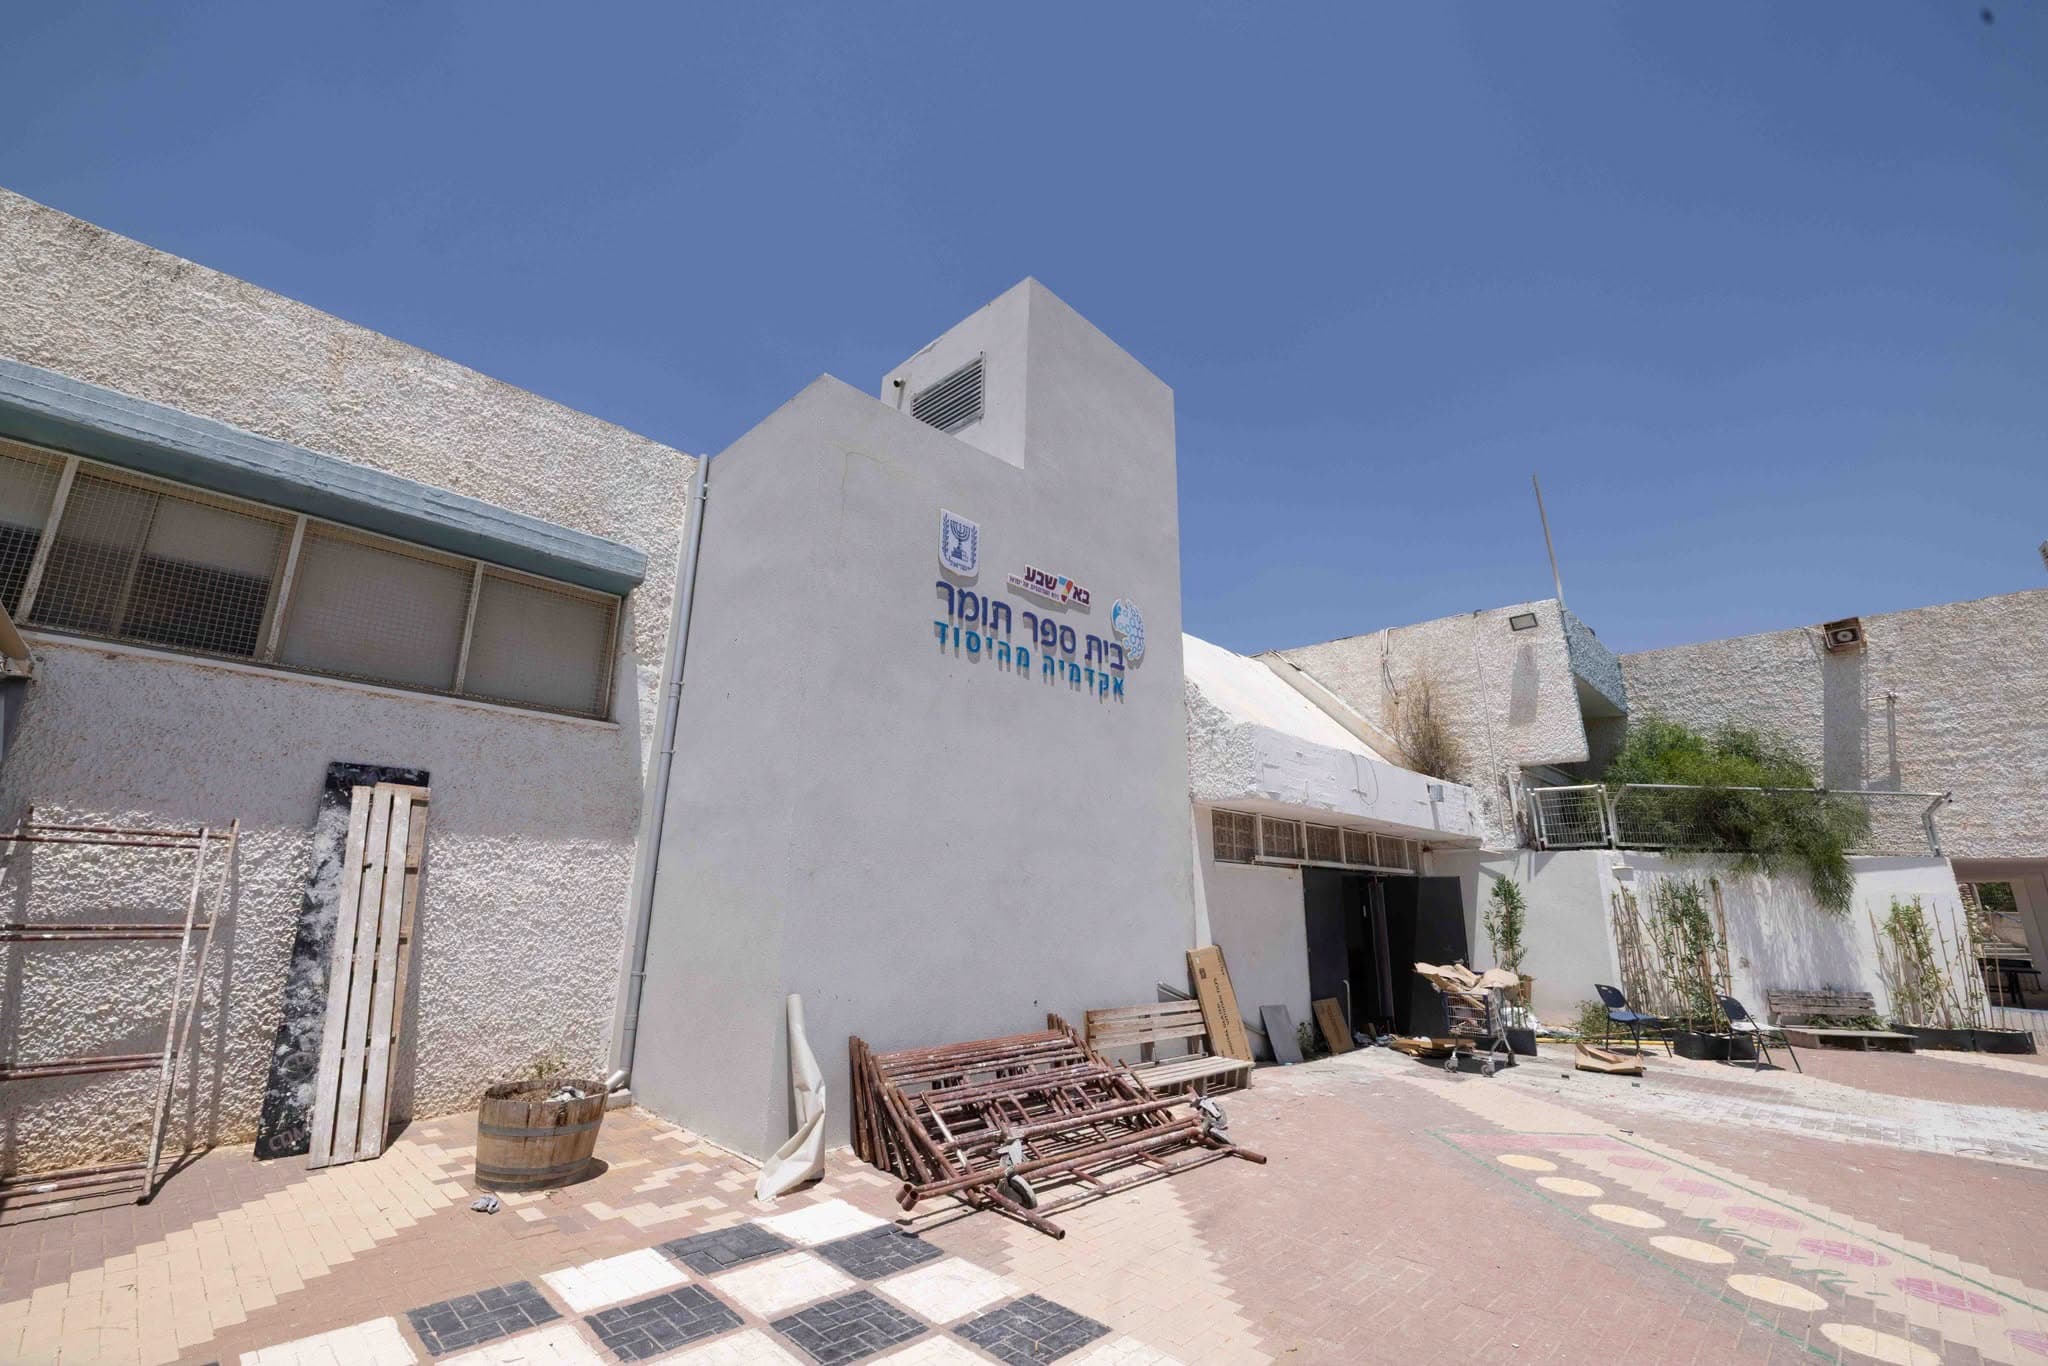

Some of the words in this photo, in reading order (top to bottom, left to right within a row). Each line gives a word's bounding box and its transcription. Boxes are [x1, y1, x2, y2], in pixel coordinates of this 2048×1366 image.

[1024, 566, 1058, 590] שבע
[936, 580, 1012, 635] תומר
[934, 620, 1030, 669] מהיסוד
[1022, 611, 1077, 654] ספר
[1084, 634, 1125, 671] בית
[1042, 655, 1125, 697] אקדמיה
